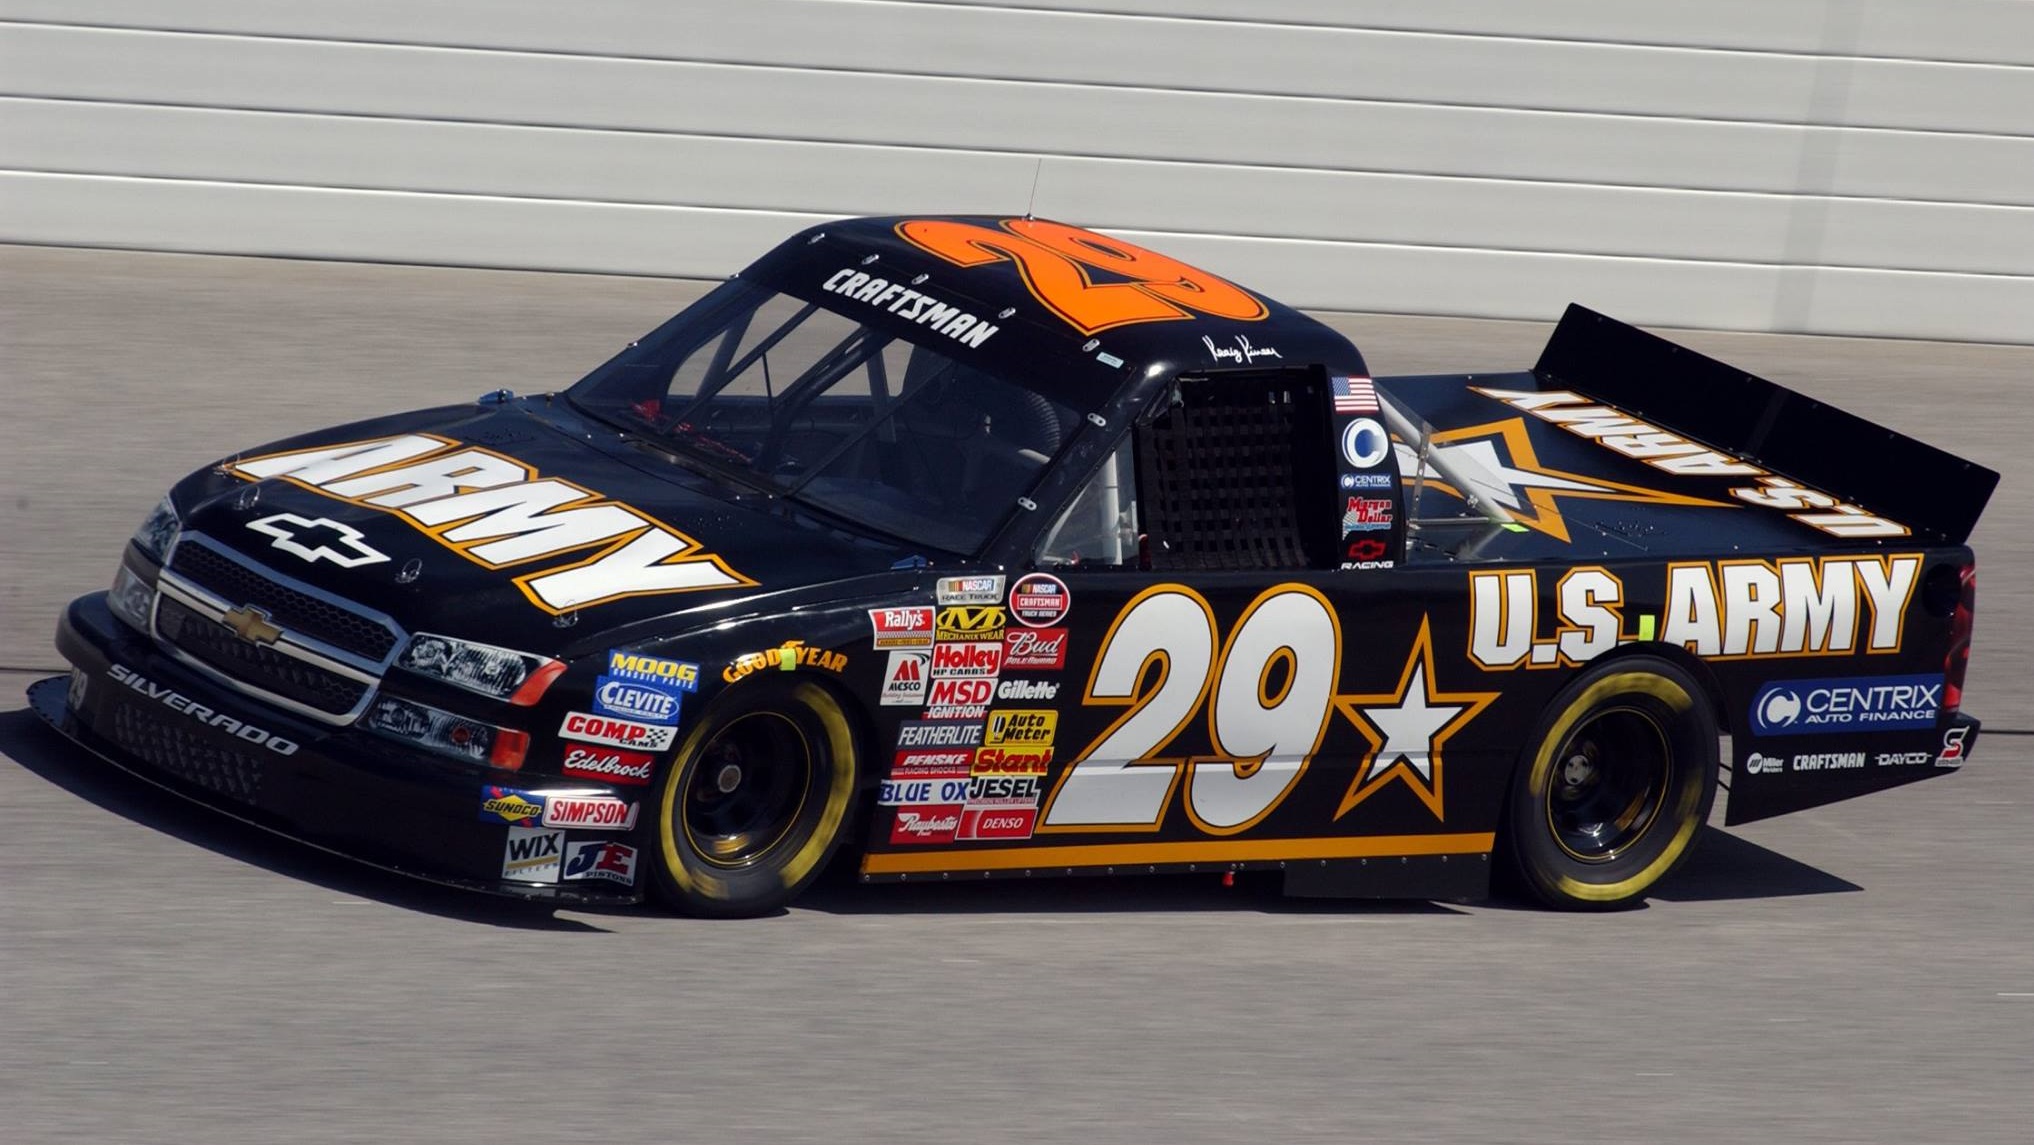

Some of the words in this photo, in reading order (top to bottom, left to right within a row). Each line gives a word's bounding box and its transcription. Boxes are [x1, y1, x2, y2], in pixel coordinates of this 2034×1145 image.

[894, 219, 1270, 337] 29
[822, 268, 998, 349] CRAFTSMAN
[1467, 386, 1775, 476] ARMY
[1354, 475, 1391, 484] CENTRIX
[225, 433, 762, 616] ARMY
[1341, 561, 1394, 570] RACING
[962, 580, 993, 592] NASCAR
[1032, 584, 1057, 593] NASCAR
[1019, 598, 1060, 607] CRAFTSMAN
[1468, 566, 1638, 672] U.S
[1659, 553, 1924, 661] ARMY
[885, 610, 924, 630] Rally's
[936, 629, 979, 641] MECHANIX
[980, 629, 1005, 640] WEAR
[1007, 632, 1064, 655] Bud
[611, 653, 699, 681] MOOG
[934, 645, 1000, 675] Holley
[601, 681, 674, 714] CLEVITE
[932, 681, 992, 706] MSD
[998, 680, 1057, 699] Gillette
[1807, 684, 1941, 713] CENTRIX
[107, 663, 298, 756] SILVERADO
[928, 706, 985, 719] IGNITION
[1035, 583, 1342, 836] 29
[1805, 714, 1852, 724] AUTO
[1859, 710, 1936, 721] FINANCE
[567, 715, 646, 740] COMP
[1009, 714, 1045, 727] Auto
[619, 738, 658, 748] CAMS
[898, 725, 982, 746] FEATHERLITE
[1003, 727, 1051, 740] Meter
[564, 750, 650, 779] Edelbrock
[903, 754, 968, 765] PENSKE
[973, 749, 1052, 773] Stant
[1793, 753, 1866, 770] CRAFTSMAN
[1877, 752, 1930, 766] DAYCO
[880, 783, 932, 802] BLUE
[941, 782, 969, 801] OX
[969, 778, 1037, 798] JESEL
[485, 800, 540, 816] SUNOCO
[551, 801, 630, 824] SIMPSON
[897, 813, 958, 833] Raybestos
[983, 817, 1024, 829] DENSO
[509, 833, 560, 861] WIX
[566, 843, 633, 877] JE
[585, 871, 632, 884] PISTONS
